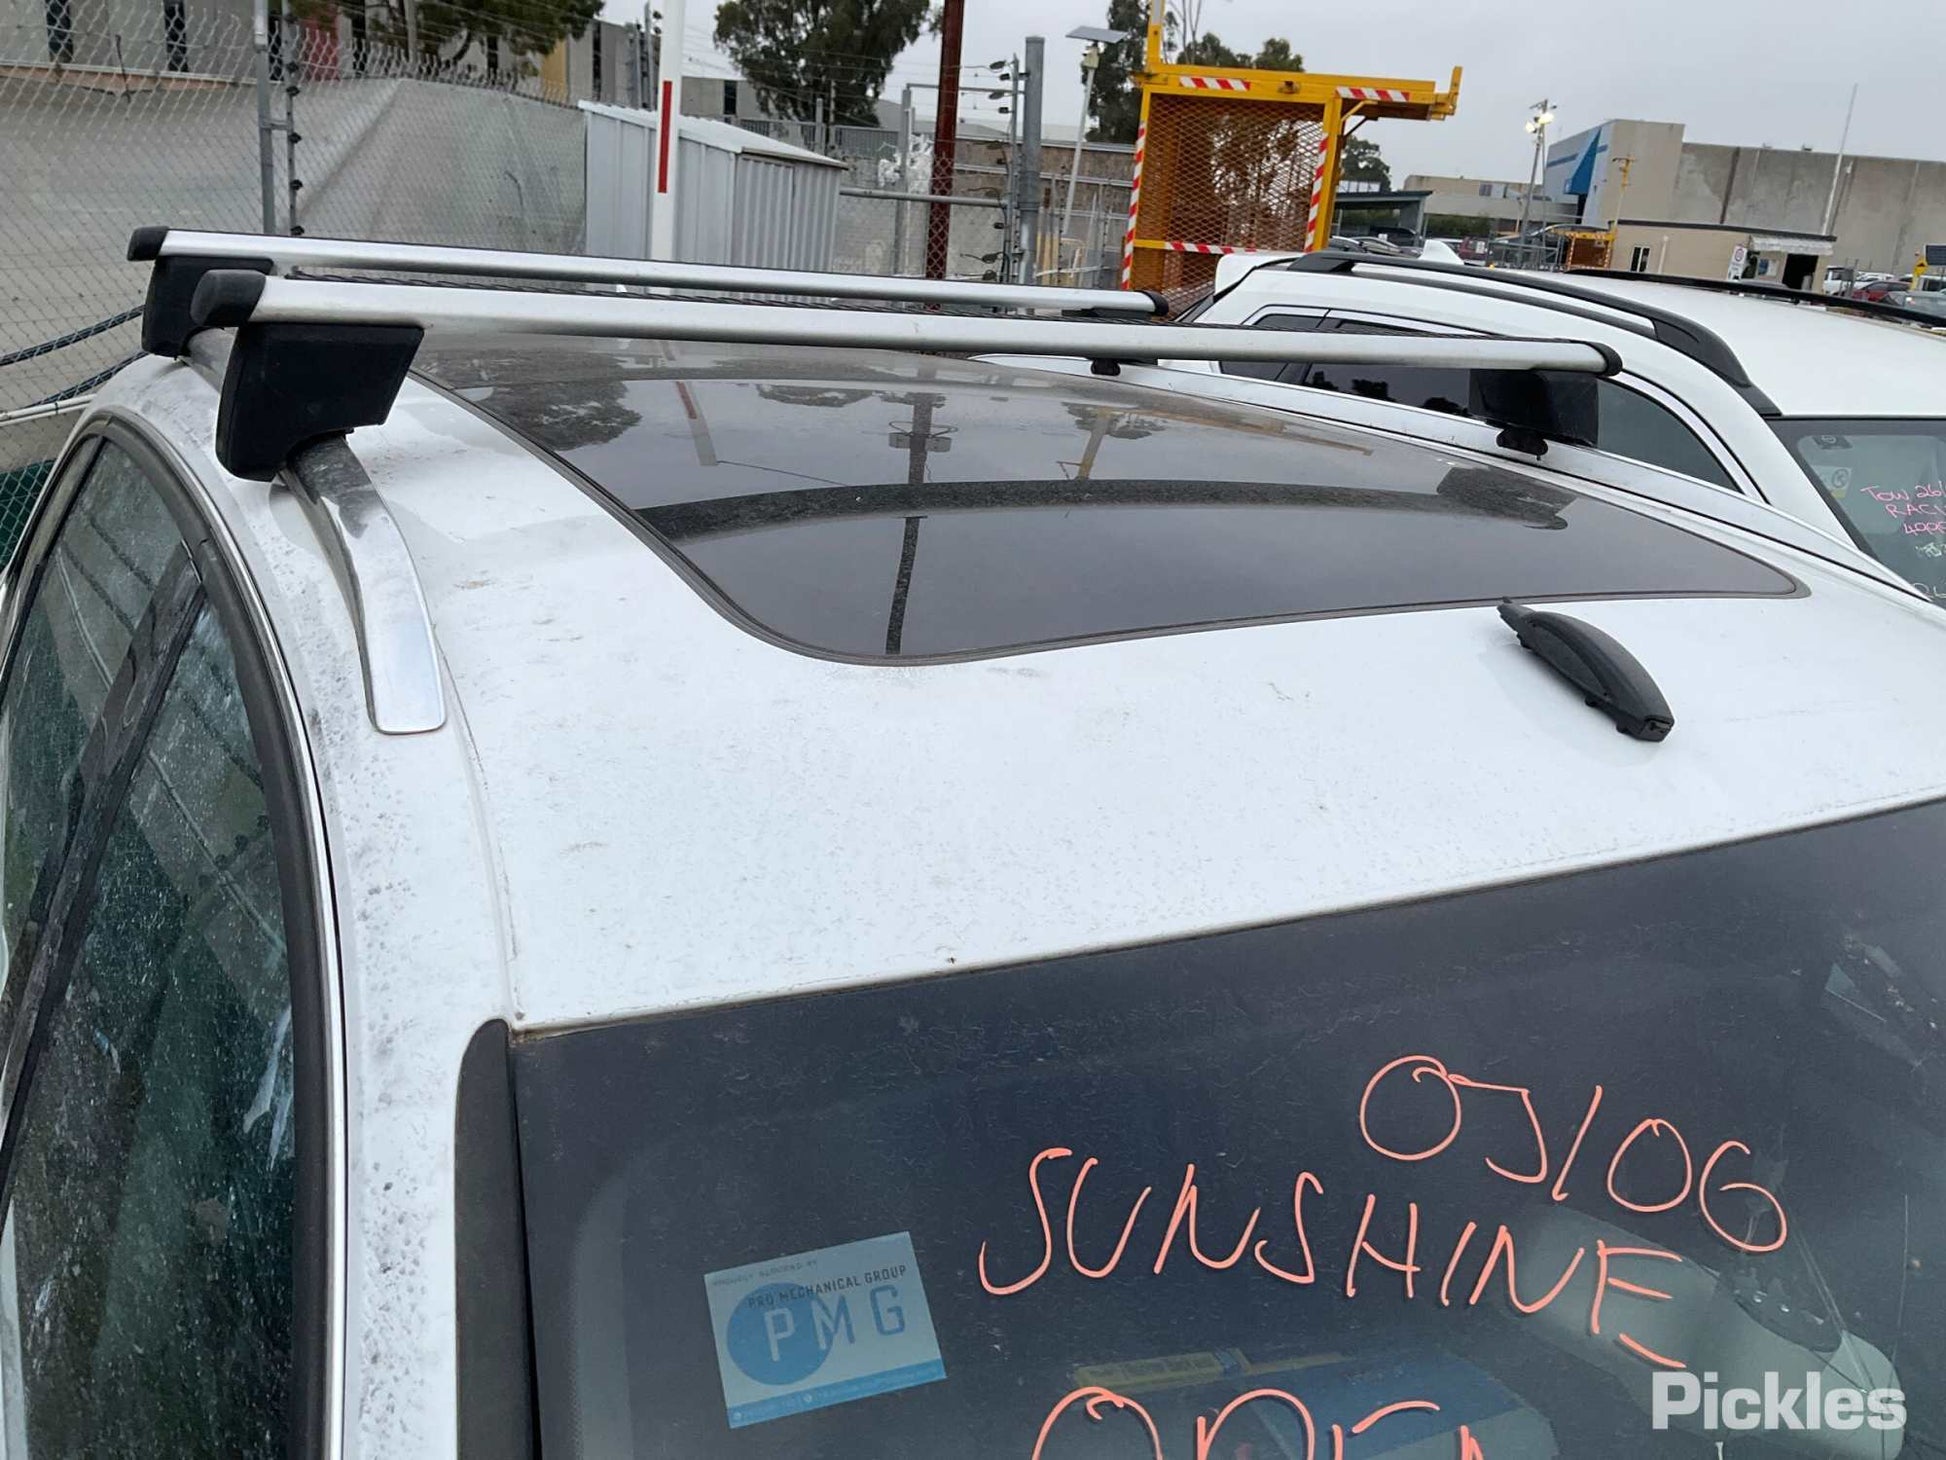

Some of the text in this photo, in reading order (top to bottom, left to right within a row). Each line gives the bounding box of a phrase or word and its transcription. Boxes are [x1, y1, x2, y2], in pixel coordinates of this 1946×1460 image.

[748, 1265, 907, 1310] PRO MECHANICAL GROUP
[978, 1147, 1692, 1368] SUNSHINE
[764, 1284, 906, 1362] PMG
